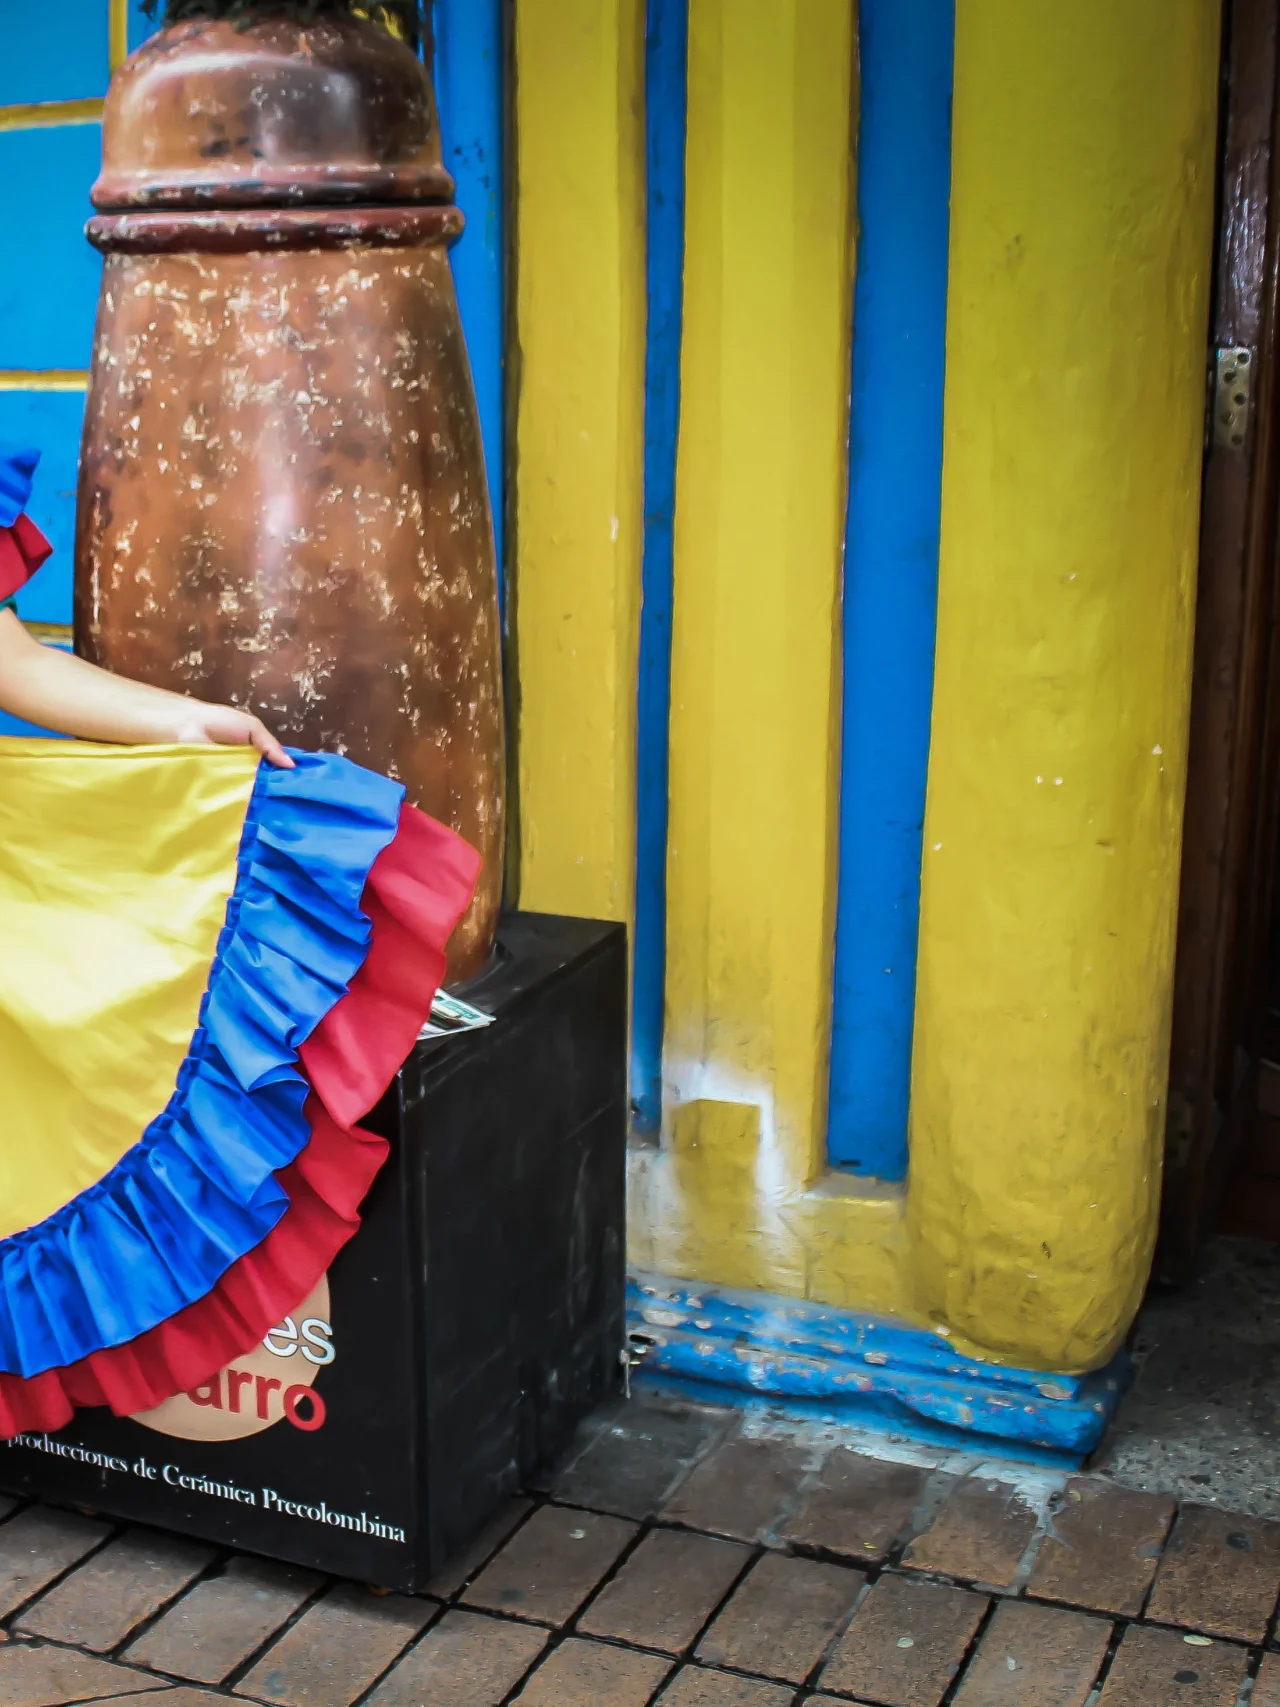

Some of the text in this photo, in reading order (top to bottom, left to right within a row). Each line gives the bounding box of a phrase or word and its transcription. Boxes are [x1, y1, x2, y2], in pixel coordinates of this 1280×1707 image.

[133, 1457, 158, 1481] de
[162, 1464, 256, 1506] Cerámica
[261, 1487, 407, 1544] Precolombina
